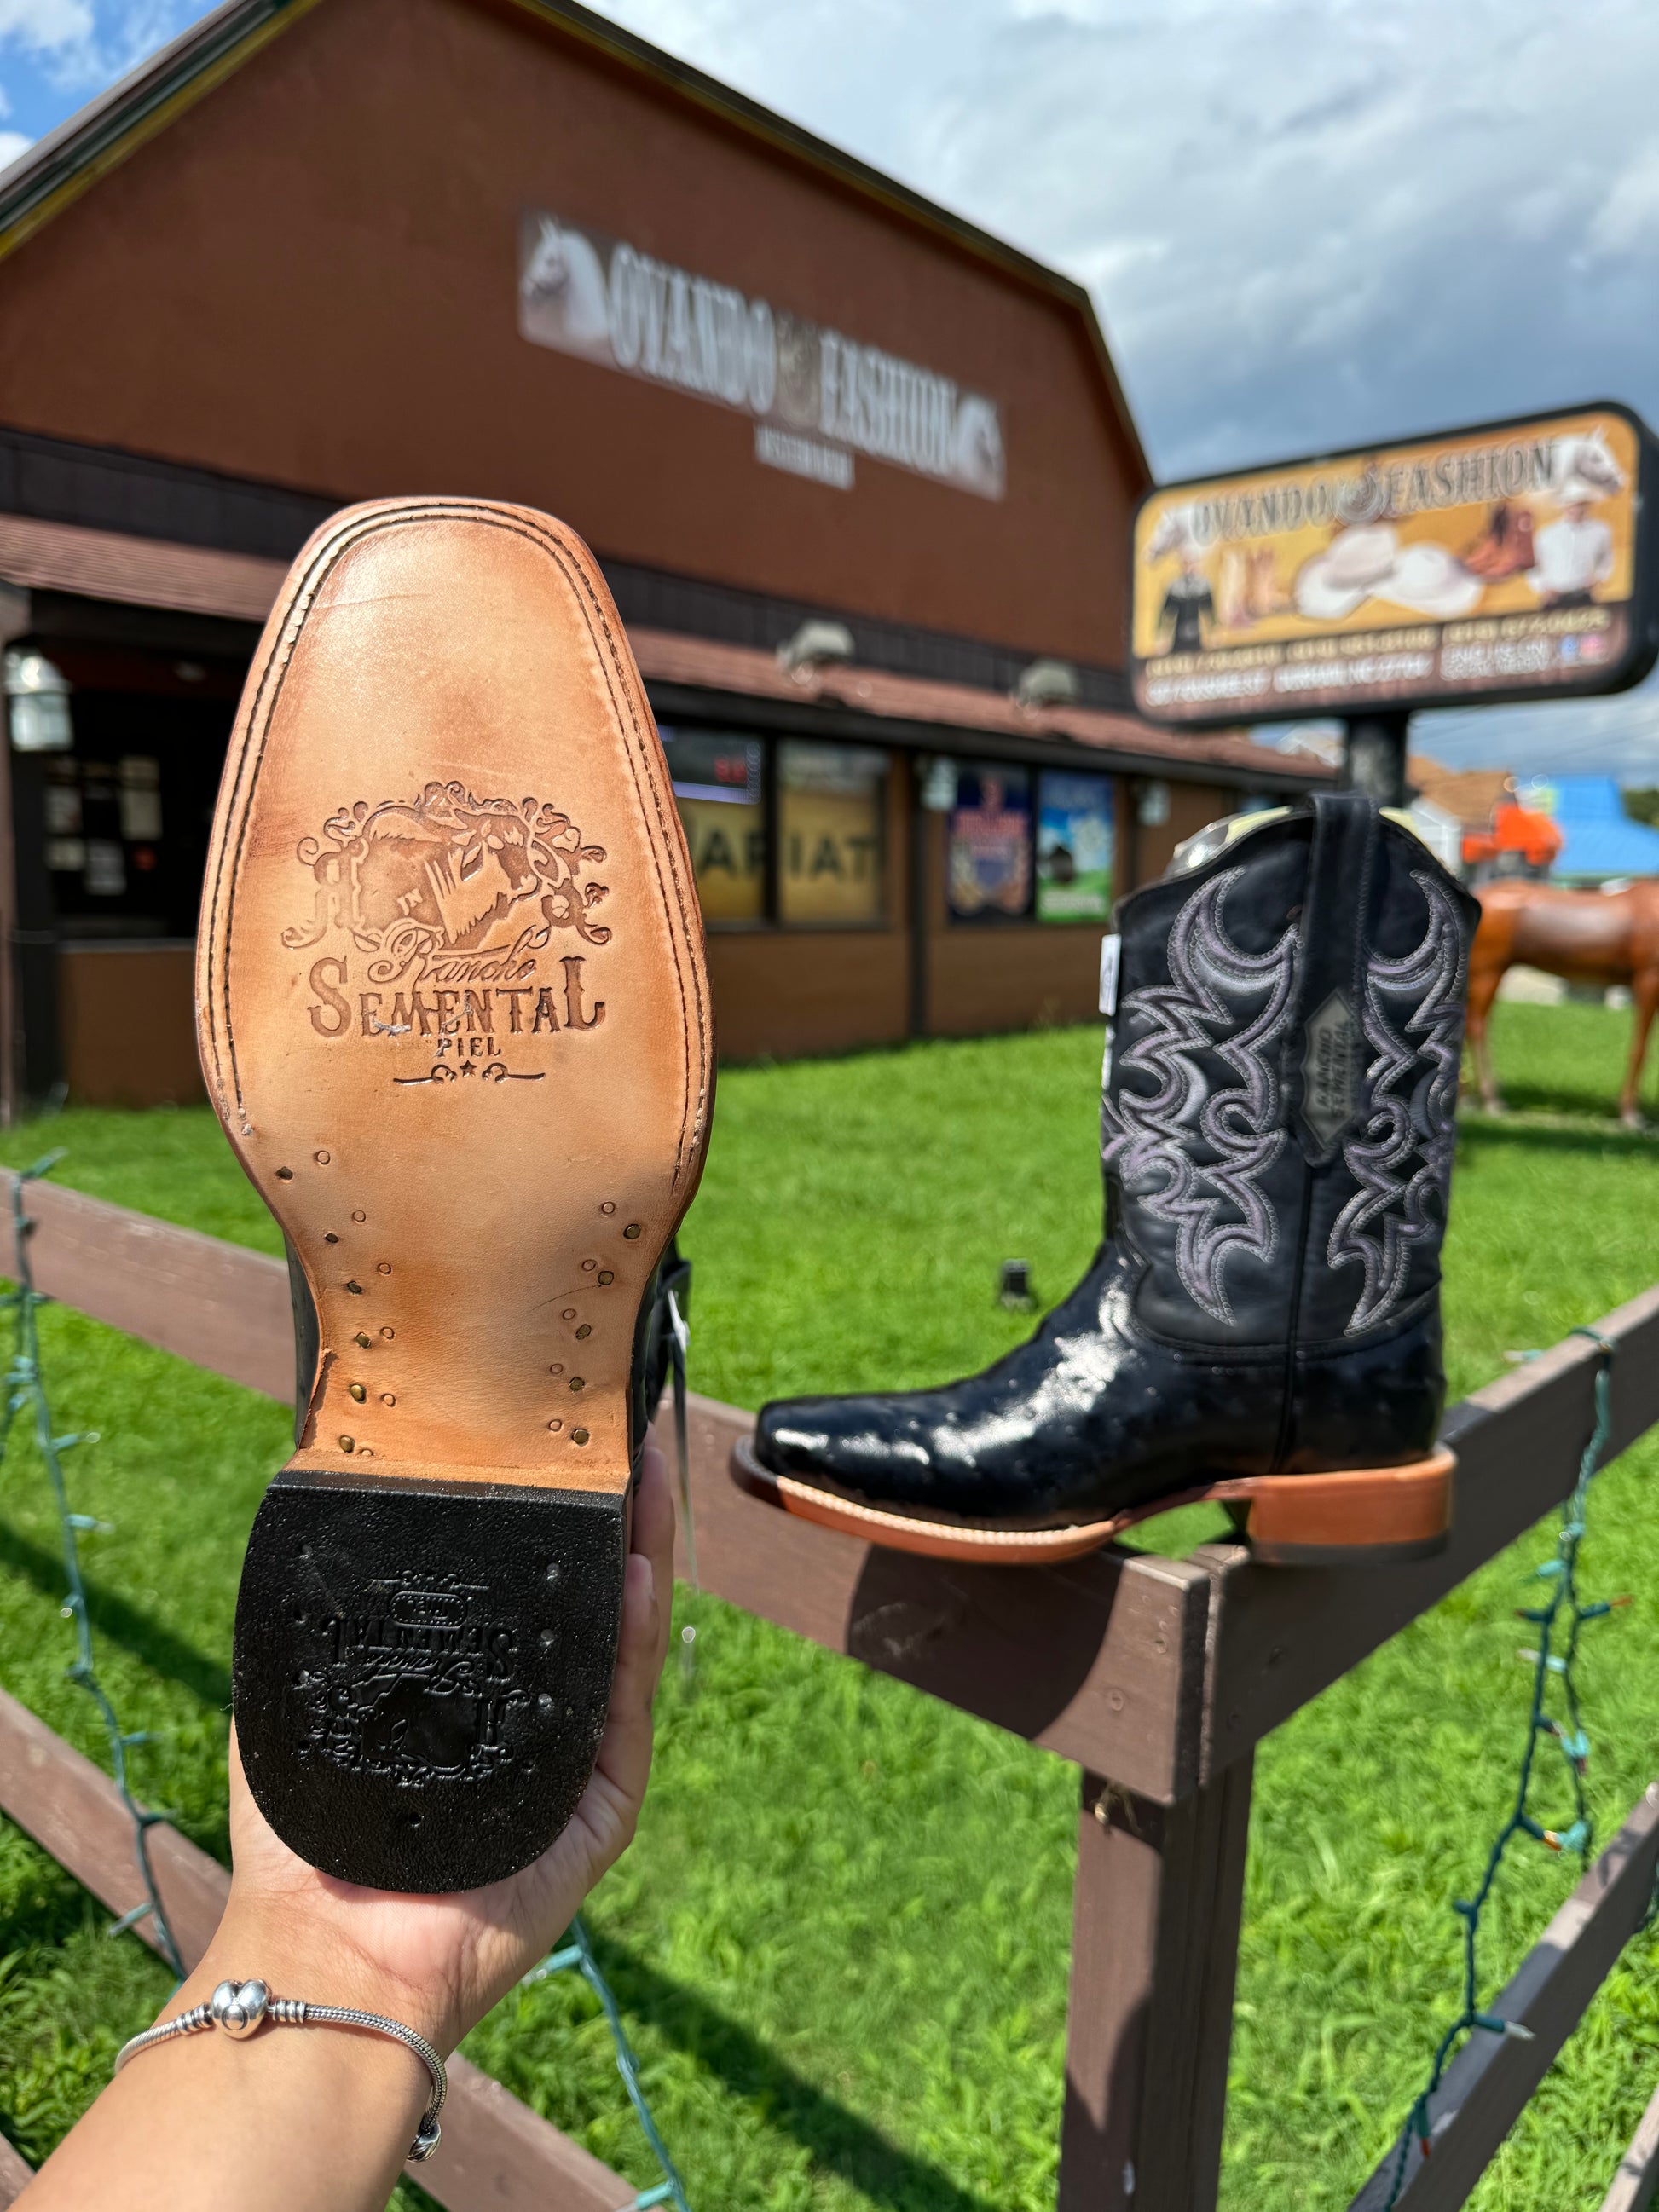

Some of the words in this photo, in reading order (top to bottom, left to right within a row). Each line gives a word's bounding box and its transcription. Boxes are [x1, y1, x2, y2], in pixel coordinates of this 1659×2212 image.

[367, 917, 551, 985] Rancho
[307, 956, 606, 1038] SEMENTAL
[436, 1037, 502, 1057] PIEL
